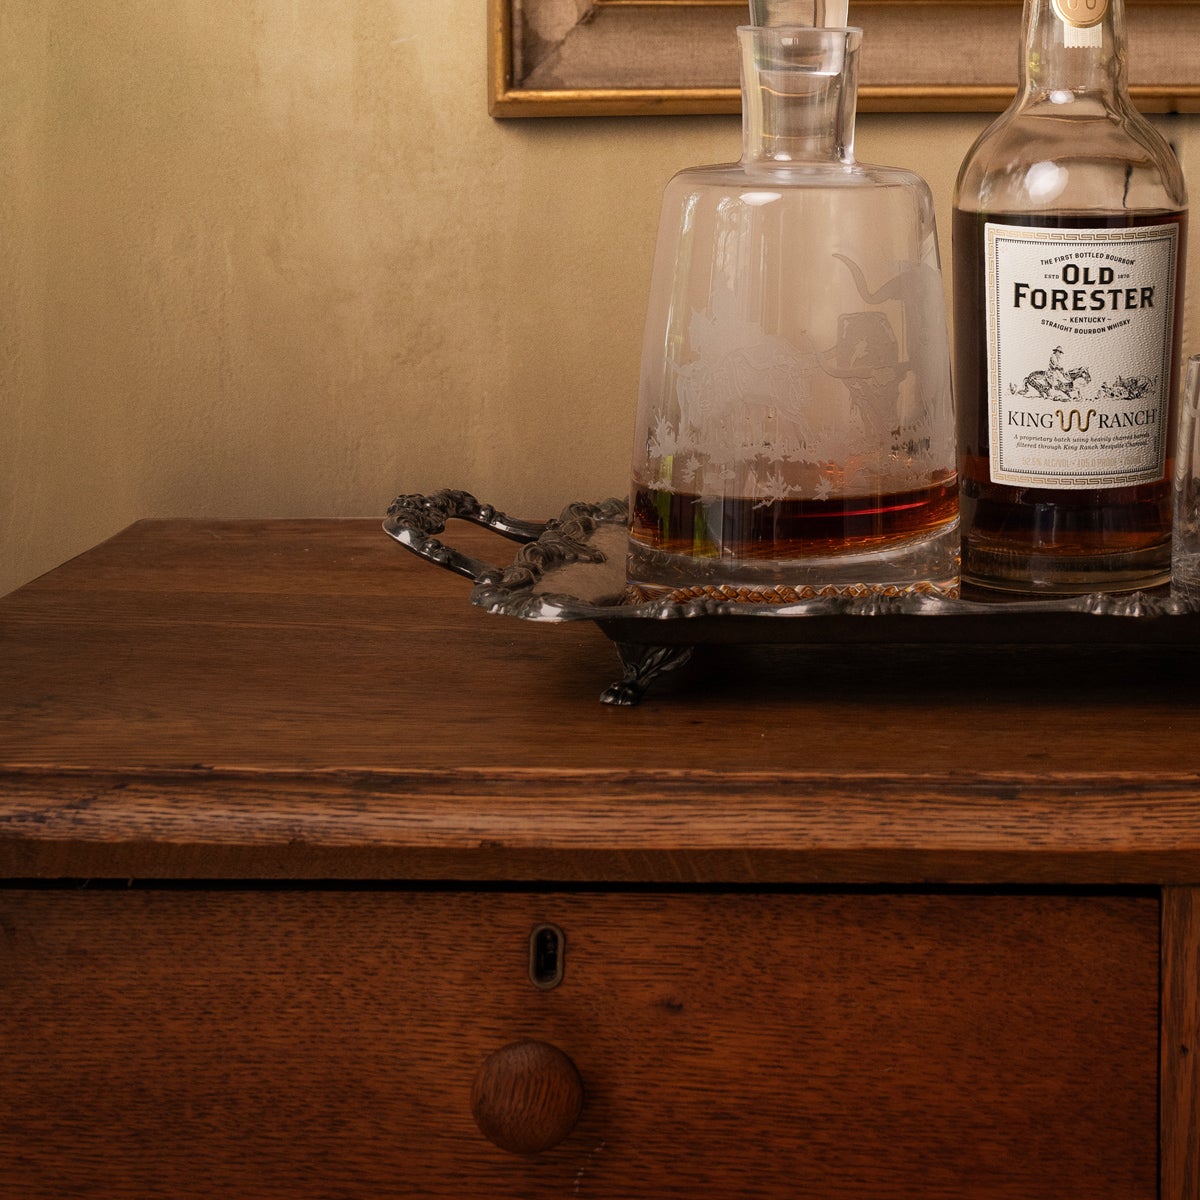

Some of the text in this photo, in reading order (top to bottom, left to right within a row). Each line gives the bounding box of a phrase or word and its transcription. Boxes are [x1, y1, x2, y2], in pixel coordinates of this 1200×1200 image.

[1040, 258, 1053, 266] THE
[1054, 253, 1073, 263] FIRST
[1105, 253, 1135, 265] BOURBON
[1062, 263, 1114, 285] OLD
[1013, 282, 1154, 311] FORESTER
[1040, 319, 1131, 335] STRAIGHT BOURBON WHISKY
[1008, 410, 1053, 429] KING
[1098, 410, 1155, 429] RANCH
[1019, 434, 1052, 443] proprietary
[1037, 443, 1061, 451] through
[1100, 443, 1125, 451] Mesquite
